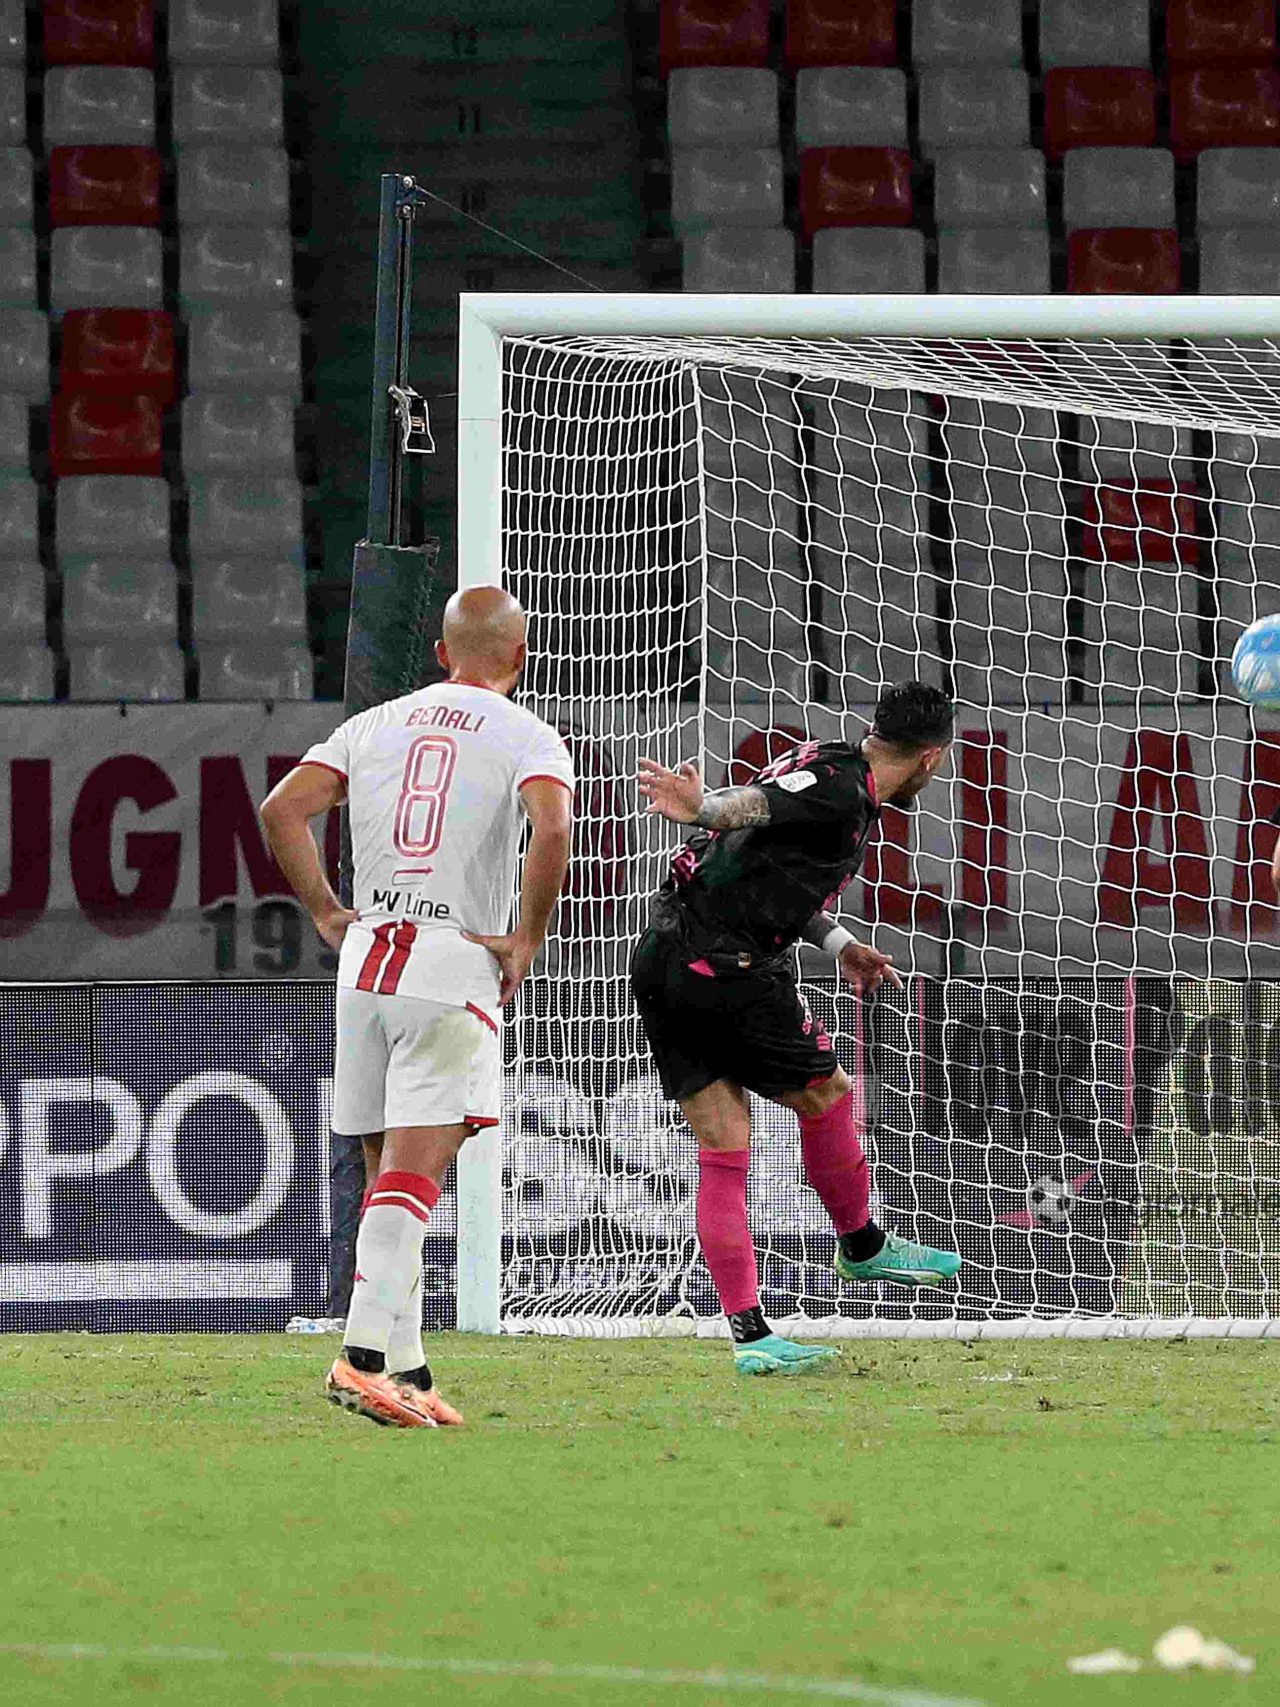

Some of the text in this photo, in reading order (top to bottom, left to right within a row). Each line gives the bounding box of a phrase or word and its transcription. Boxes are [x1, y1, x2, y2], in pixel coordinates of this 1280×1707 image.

[405, 705, 487, 733] BENALI
[393, 734, 460, 859] 8
[0, 1070, 296, 1238] PO
